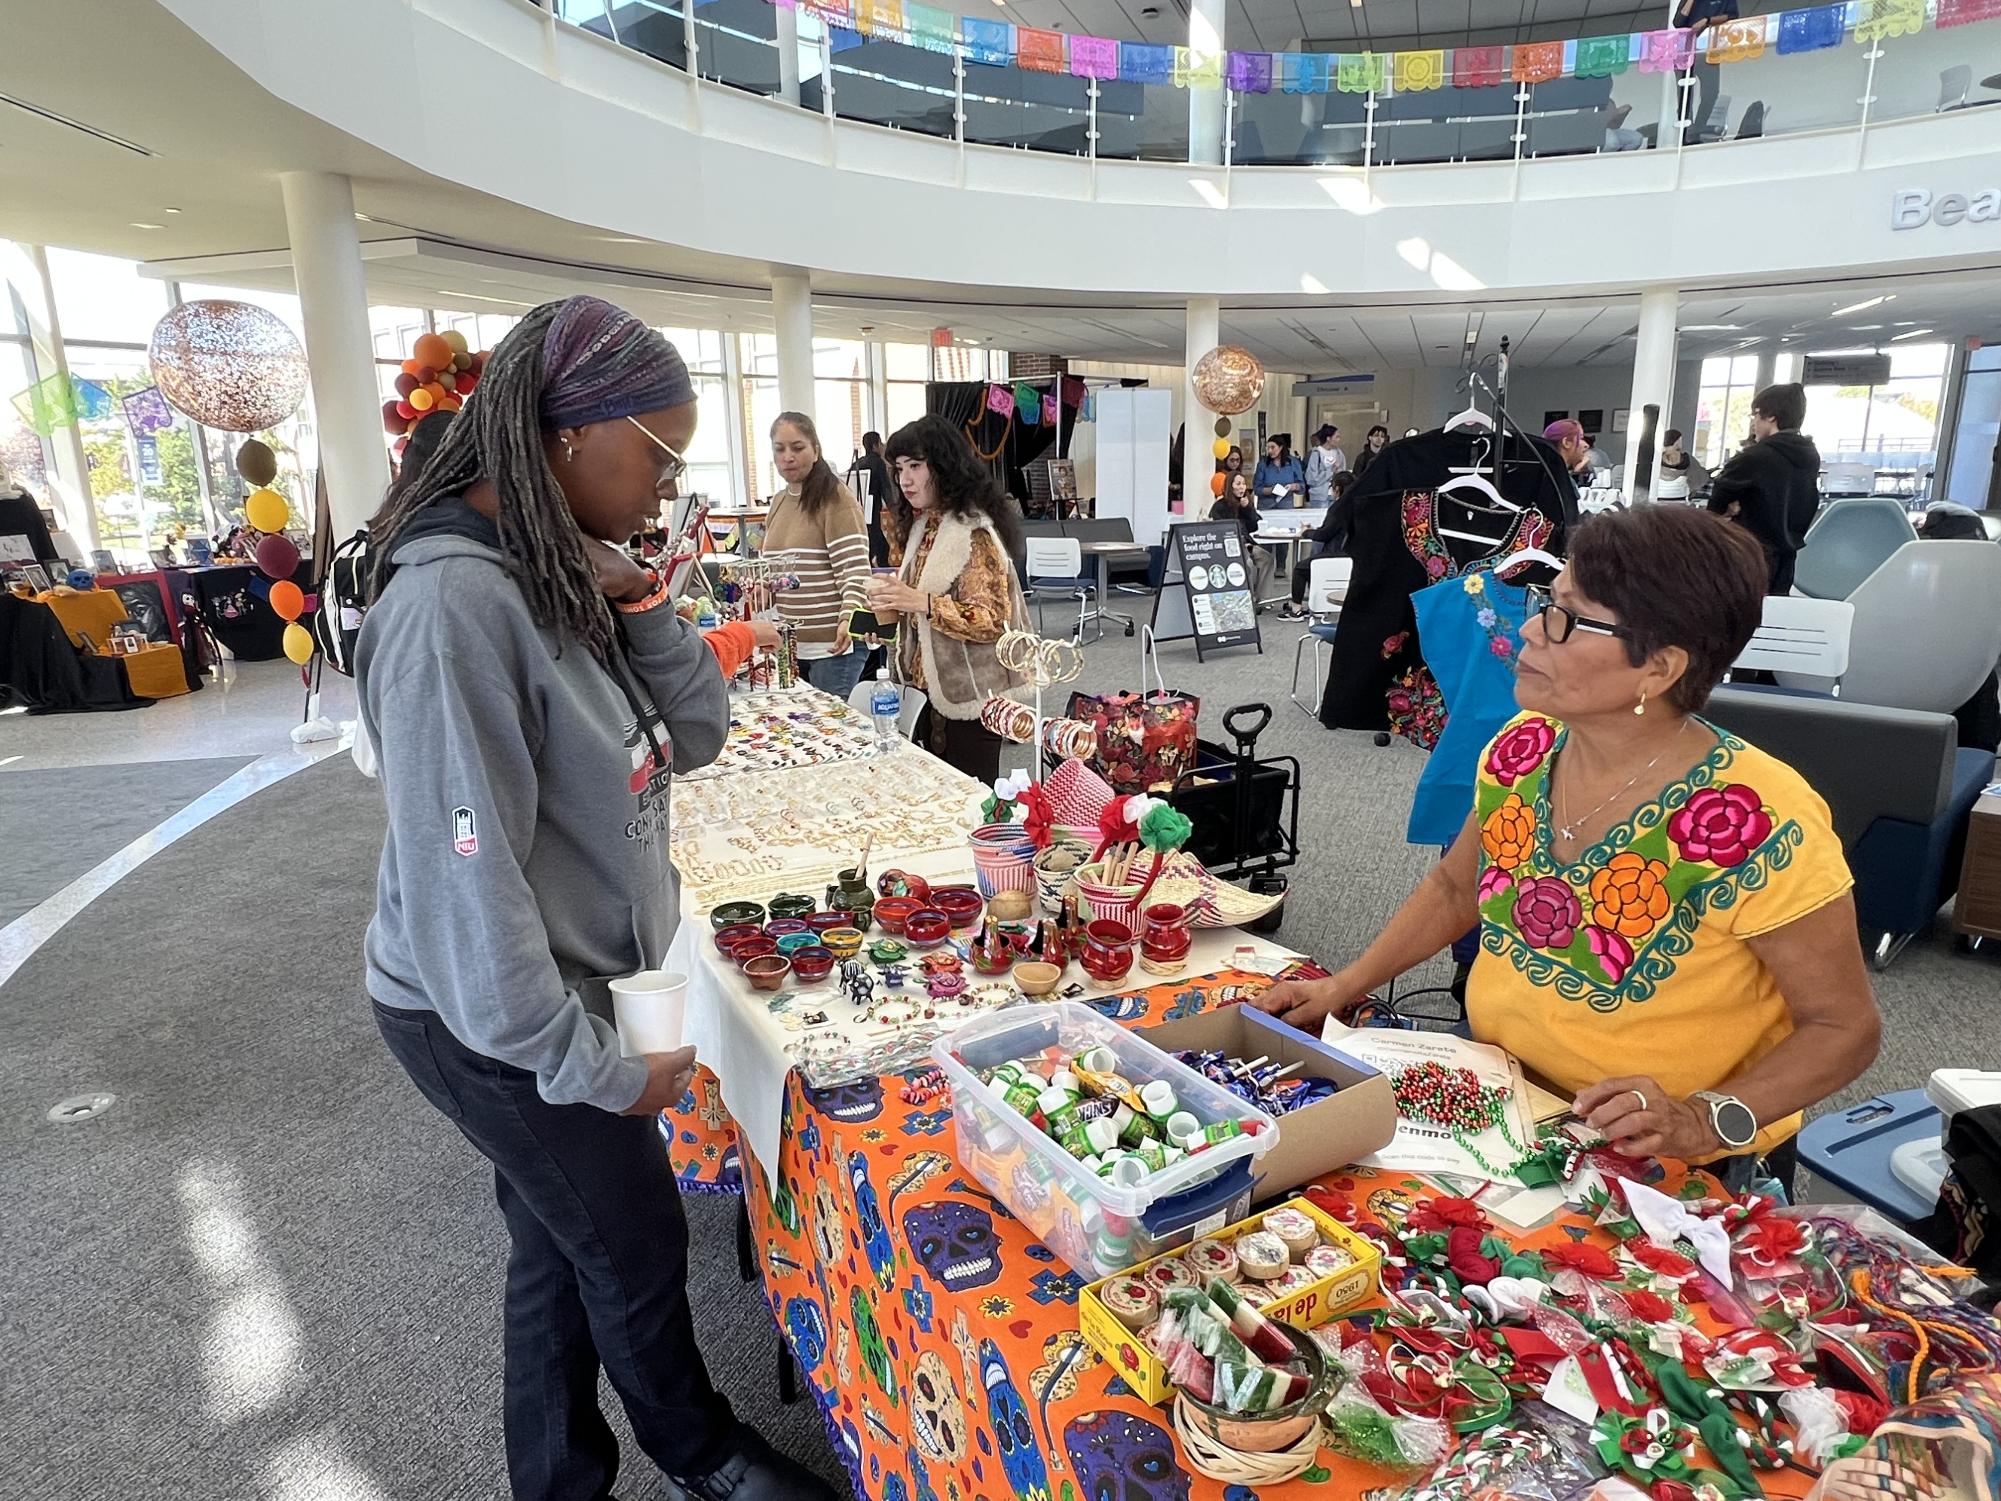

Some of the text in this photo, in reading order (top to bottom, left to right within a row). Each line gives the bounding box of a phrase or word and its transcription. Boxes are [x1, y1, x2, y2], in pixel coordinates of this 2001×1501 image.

[1892, 189, 2001, 231] Bea
[1182, 533, 1206, 544] Explore
[1207, 533, 1217, 541] the
[1184, 543, 1199, 551] food
[1199, 542, 1213, 551] right
[458, 842, 475, 851] NIU
[1371, 1037, 1415, 1048] Carmen
[1418, 1042, 1457, 1054] Zarate
[1077, 1101, 1112, 1121] SNICK
[1398, 1125, 1452, 1140] enmo
[1295, 1292, 1317, 1322] de
